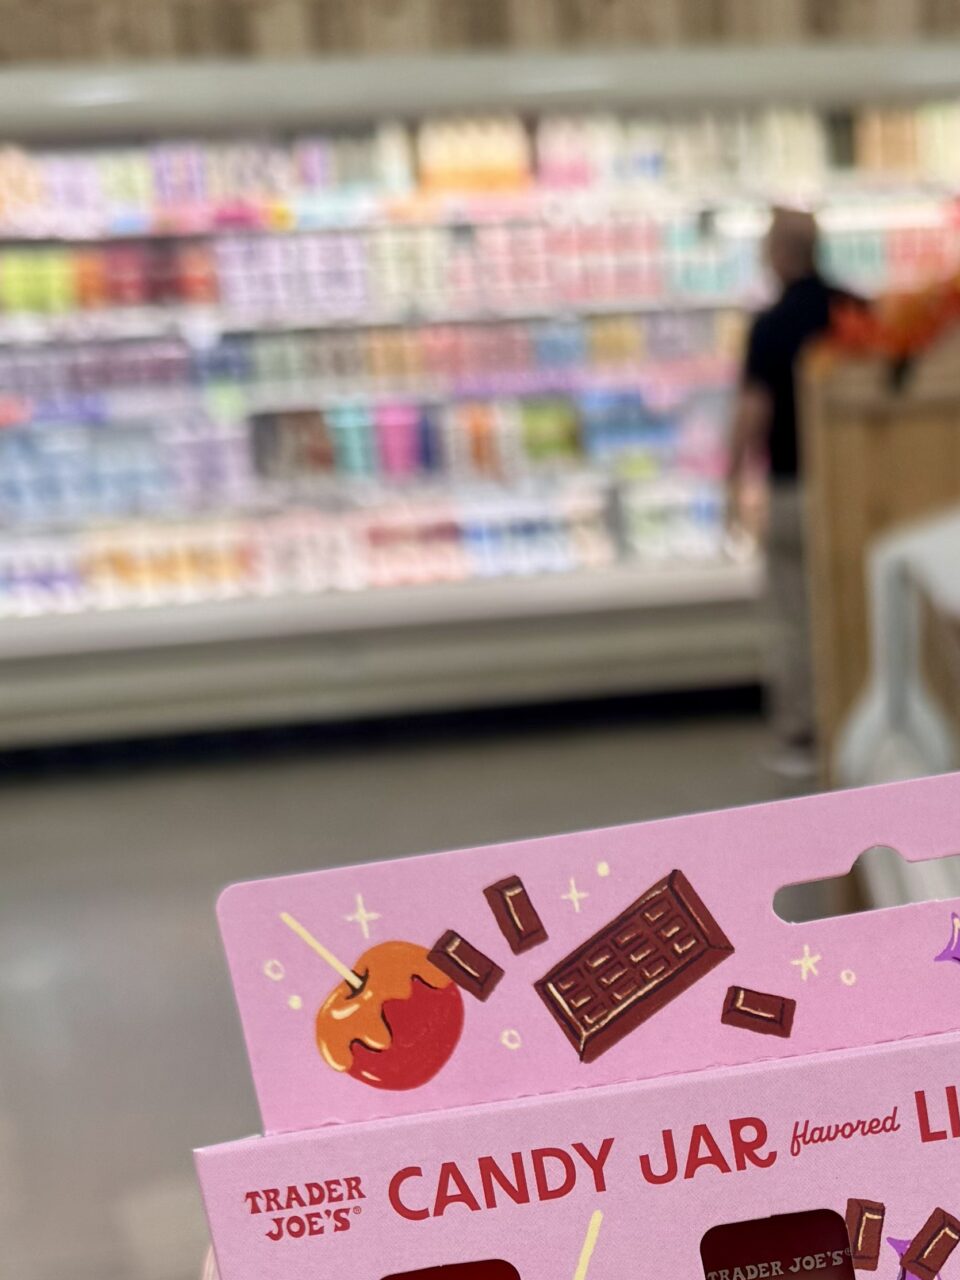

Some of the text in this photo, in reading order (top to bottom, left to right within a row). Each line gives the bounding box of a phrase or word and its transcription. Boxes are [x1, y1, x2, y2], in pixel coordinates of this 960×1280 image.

[244, 1175, 367, 1216] TRADER
[388, 1137, 615, 1222] CANDY
[639, 1116, 778, 1186] JAR
[789, 1107, 901, 1157] flavored
